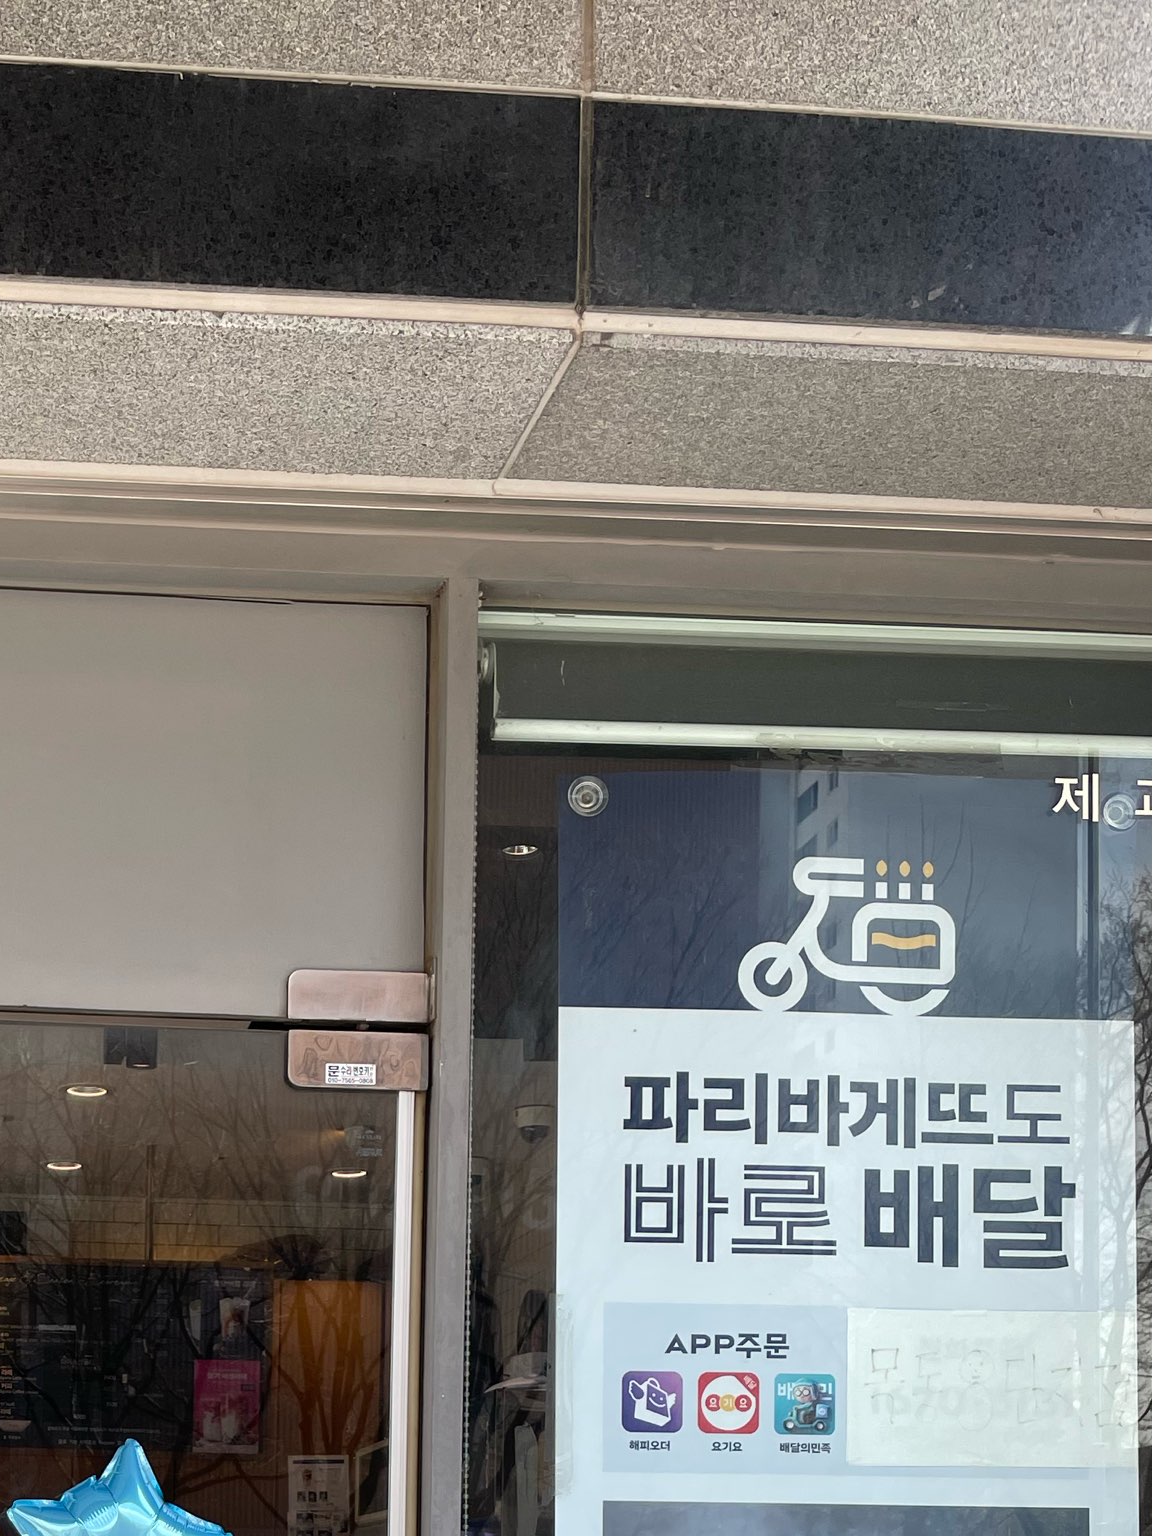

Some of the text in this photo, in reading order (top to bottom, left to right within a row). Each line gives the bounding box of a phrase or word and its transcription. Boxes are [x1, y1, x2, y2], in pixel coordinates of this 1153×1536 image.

[623, 1071, 1071, 1148] 파리바게뜨도
[624, 1157, 1076, 1268] 바로 배달
[665, 1333, 790, 1360] APP주문
[629, 1440, 671, 1452] 해피오더
[711, 1442, 743, 1453] 요기요
[779, 1442, 832, 1454] 배달의민족
